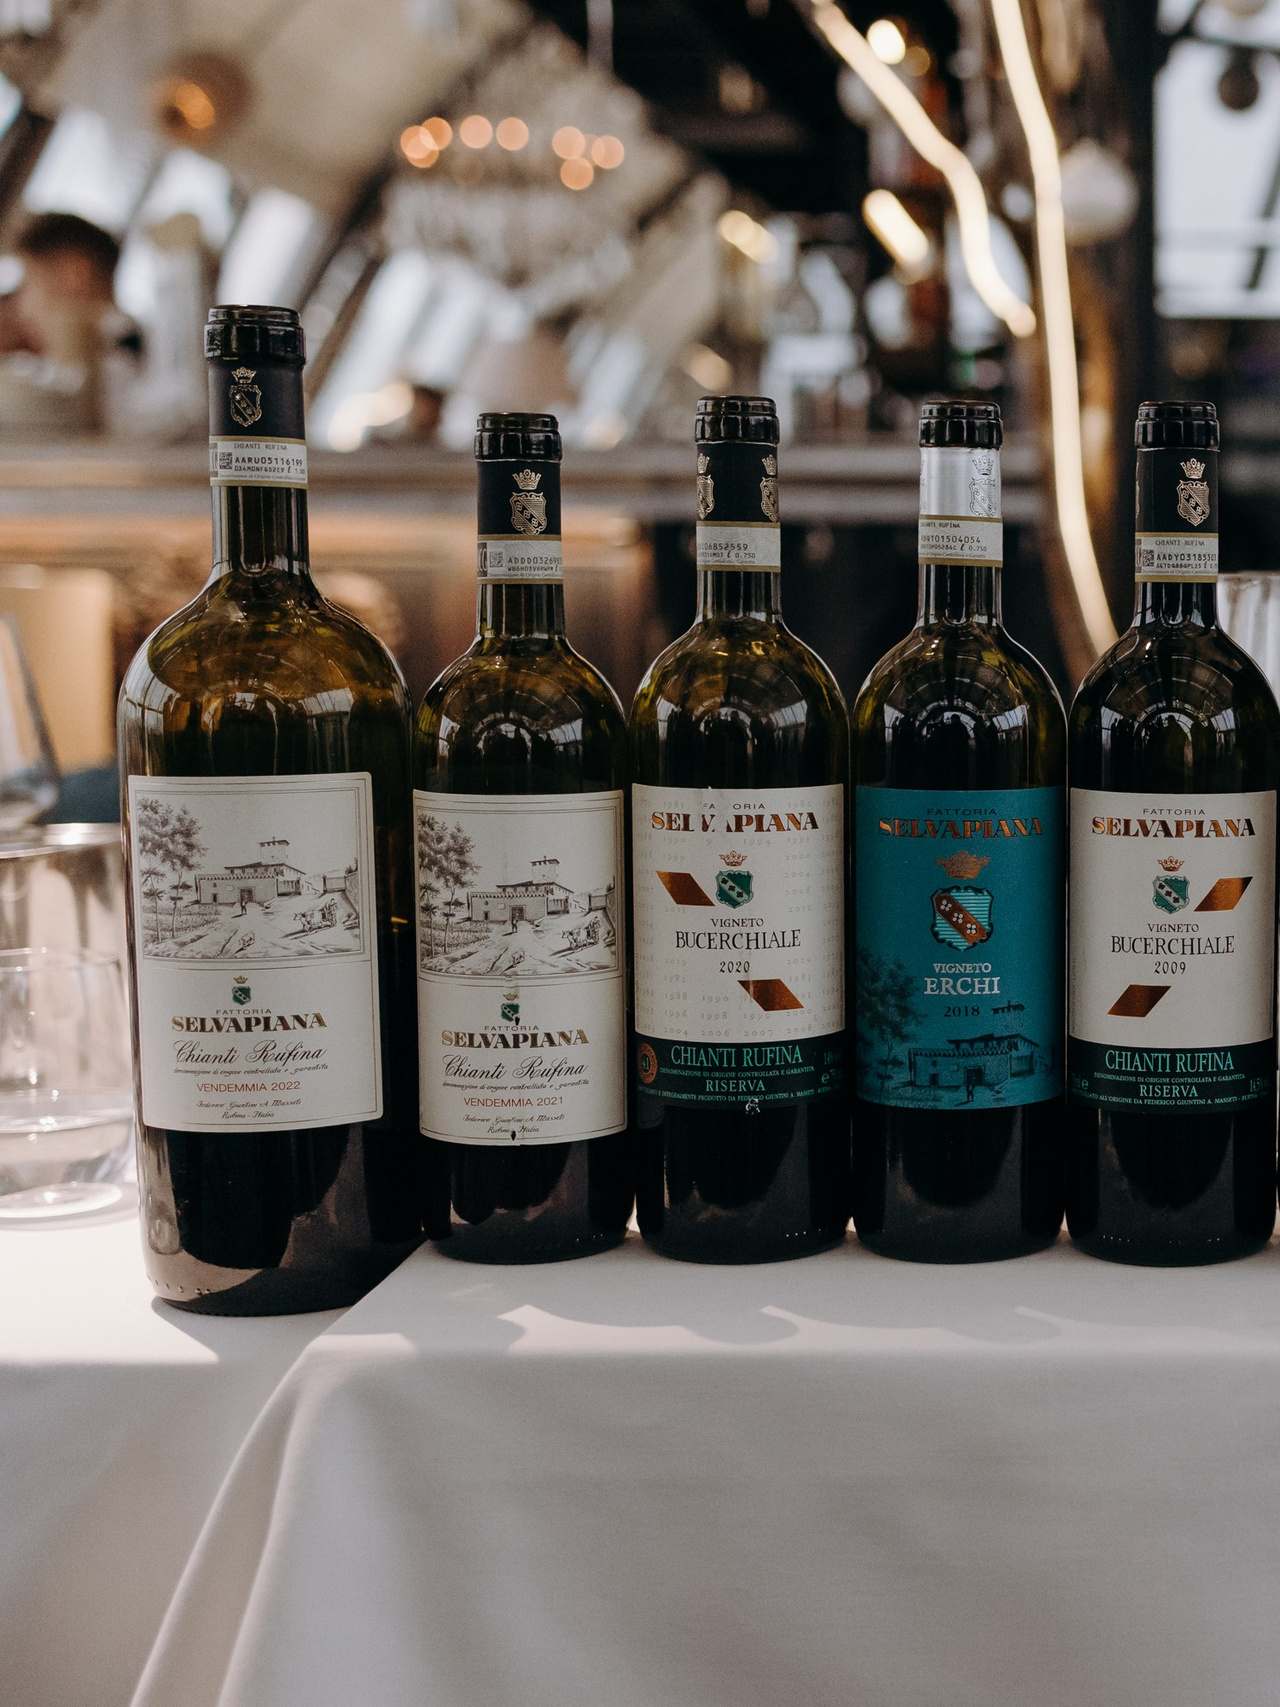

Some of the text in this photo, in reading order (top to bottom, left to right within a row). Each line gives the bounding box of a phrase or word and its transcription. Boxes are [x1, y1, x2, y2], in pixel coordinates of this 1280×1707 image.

[927, 808, 998, 816] FATTORIA
[1142, 808, 1206, 816] FATTORIA
[878, 817, 1044, 839] SELVAPIANA
[1091, 816, 1256, 838] SELVAPIANA
[710, 917, 764, 928] VIGNETO
[1147, 923, 1199, 933] VIGNETO
[675, 929, 801, 950] BUCERCHIALE
[1111, 935, 1235, 955] BUCERCHIALE
[719, 960, 750, 974] 2020
[933, 962, 992, 974] VIGNETO
[1154, 961, 1187, 975] 2009
[923, 976, 1001, 996] ERCHI
[943, 1005, 980, 1018] 2018
[171, 1012, 328, 1033] SELVAPIANA
[441, 1029, 589, 1049] SELVAPIANA
[173, 1039, 327, 1067] Chianti Rufina
[671, 1045, 736, 1067] CHIANTI
[743, 1045, 803, 1067] RUFINA
[1105, 1049, 1235, 1073] CHIANTI RUFINA
[442, 1055, 588, 1083] Chianti Rufina
[659, 1067, 701, 1077] DENOMINAZIONE
[738, 1069, 779, 1077] CONTROLLATA
[1094, 1071, 1136, 1082] DENOMINAZIONE
[197, 1081, 300, 1092] VENDEMMIA 2022
[705, 1079, 766, 1092] RISERVA
[1140, 1084, 1199, 1097] RISERVA
[464, 1096, 563, 1107] VENDEMMIA 2021
